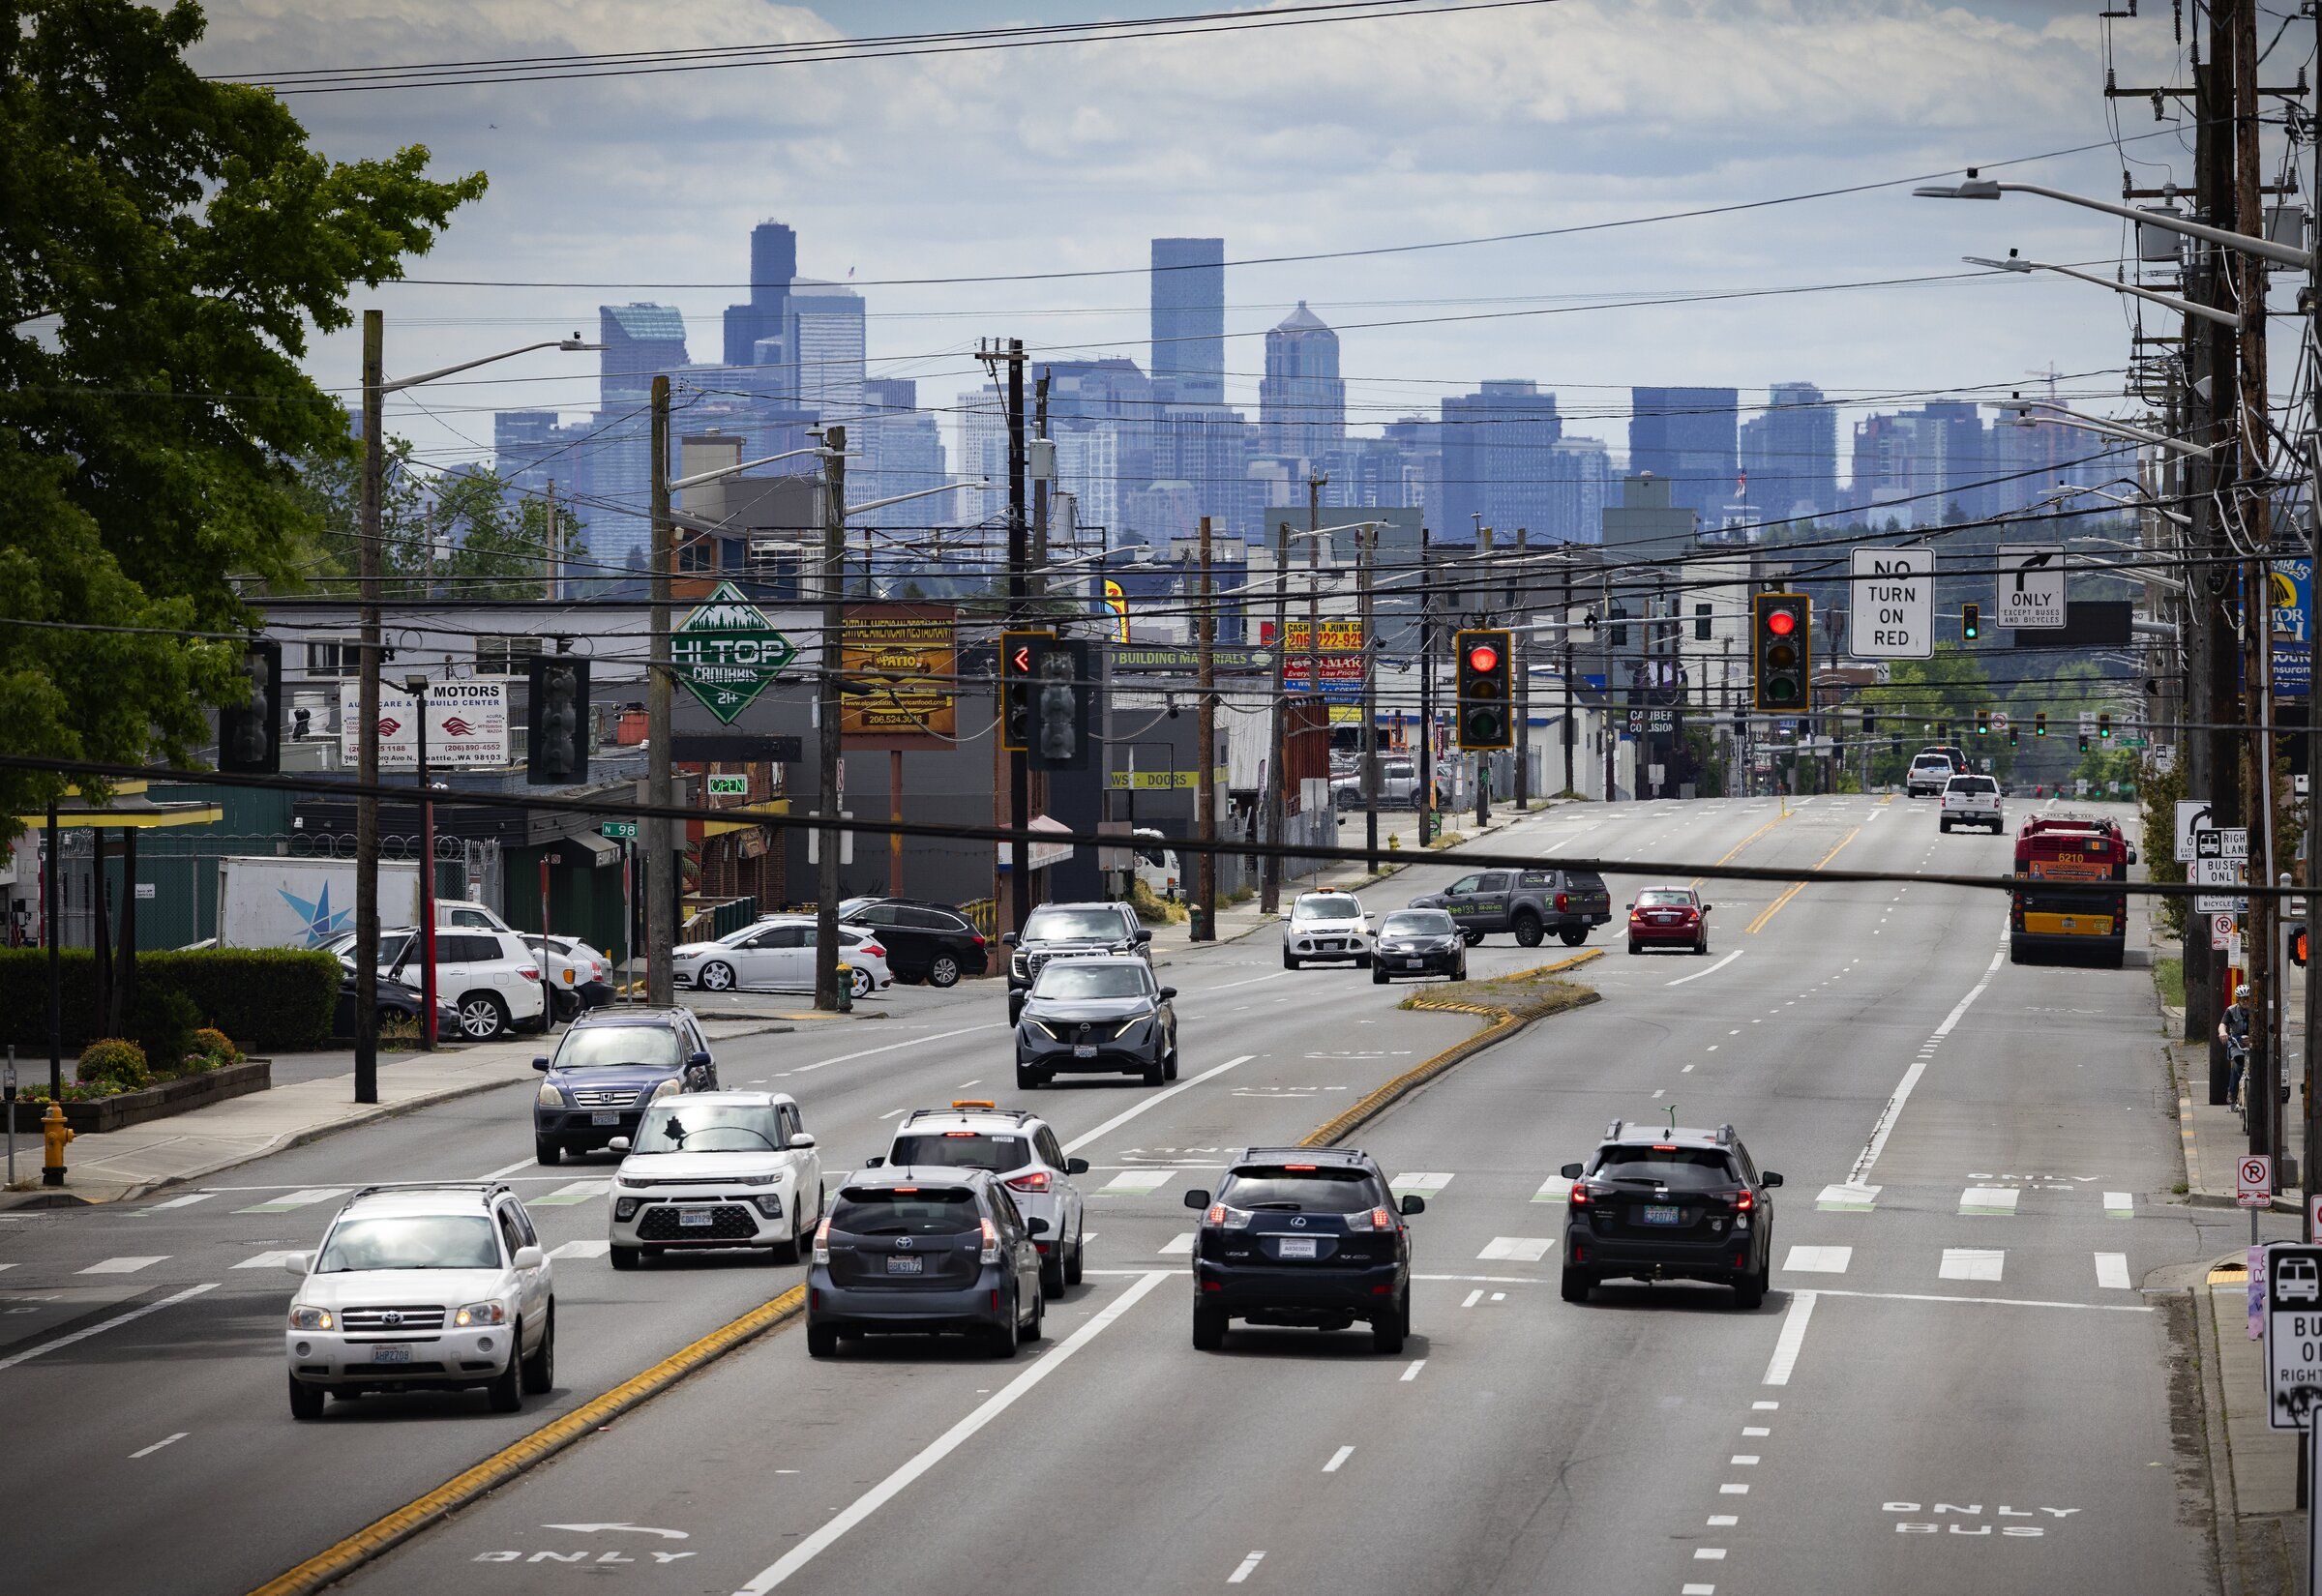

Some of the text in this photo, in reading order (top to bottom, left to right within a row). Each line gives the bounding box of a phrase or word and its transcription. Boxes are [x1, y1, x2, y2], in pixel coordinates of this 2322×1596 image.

[1875, 560, 1912, 580] NO
[1868, 586, 1916, 603] TURN
[2011, 593, 2052, 606] ONLY
[1879, 608, 1904, 624] ON
[1288, 624, 1309, 634] CASH
[1328, 624, 1350, 634] JUNK
[1874, 631, 1909, 645] RED
[670, 639, 785, 665] HI TOP
[1118, 652, 1248, 665] BUILDING MARIALS
[881, 655, 916, 667] PATIO
[693, 665, 759, 683] CANNABIS
[433, 686, 500, 697] MOTORS
[717, 693, 738, 704] 21+
[1630, 710, 1673, 722] CAIBER
[711, 779, 745, 792] OPEN
[1147, 774, 1187, 785] DOORS
[618, 825, 636, 836] 98
[2223, 834, 2246, 843] RIGH
[2058, 852, 2084, 863] 6210
[1882, 1501, 2083, 1518] ONLY
[1894, 1522, 2044, 1537] BUS
[470, 1550, 700, 1564] ONLY
